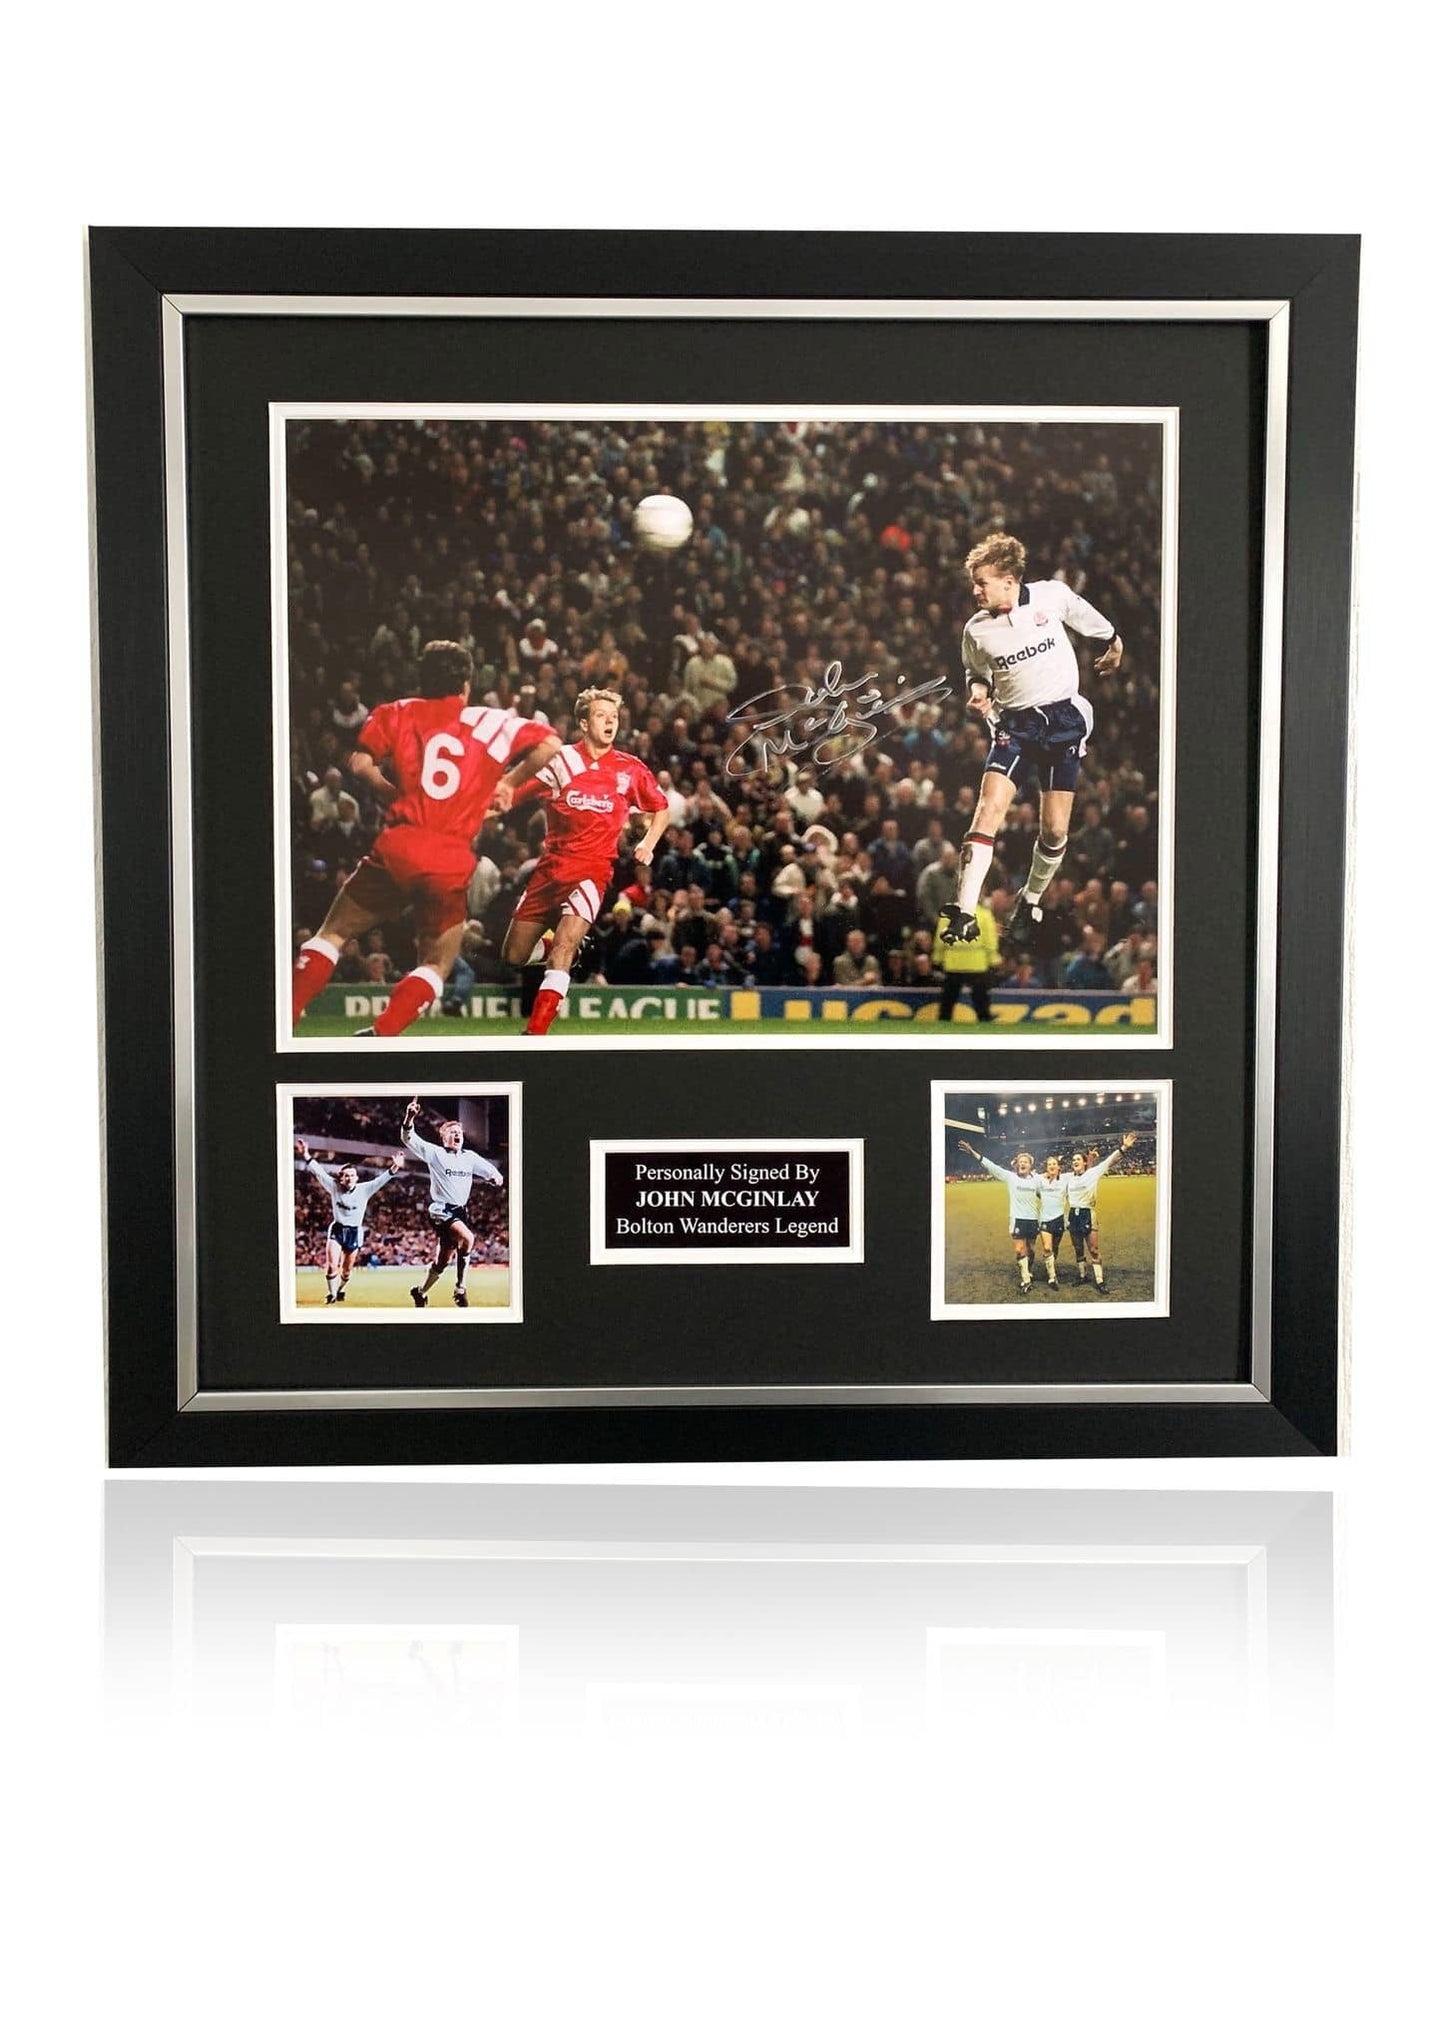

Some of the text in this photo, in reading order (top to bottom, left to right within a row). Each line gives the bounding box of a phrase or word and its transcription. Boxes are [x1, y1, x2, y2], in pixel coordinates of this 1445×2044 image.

[994, 637, 1056, 671] Reebok
[420, 733, 465, 800] 6
[565, 789, 614, 814] Carlsberg
[635, 1163, 820, 1185] Personally Signed By
[636, 1190, 819, 1208] JOHN MCGINLAY
[616, 1217, 839, 1238] Bolton Wanderers Legend
